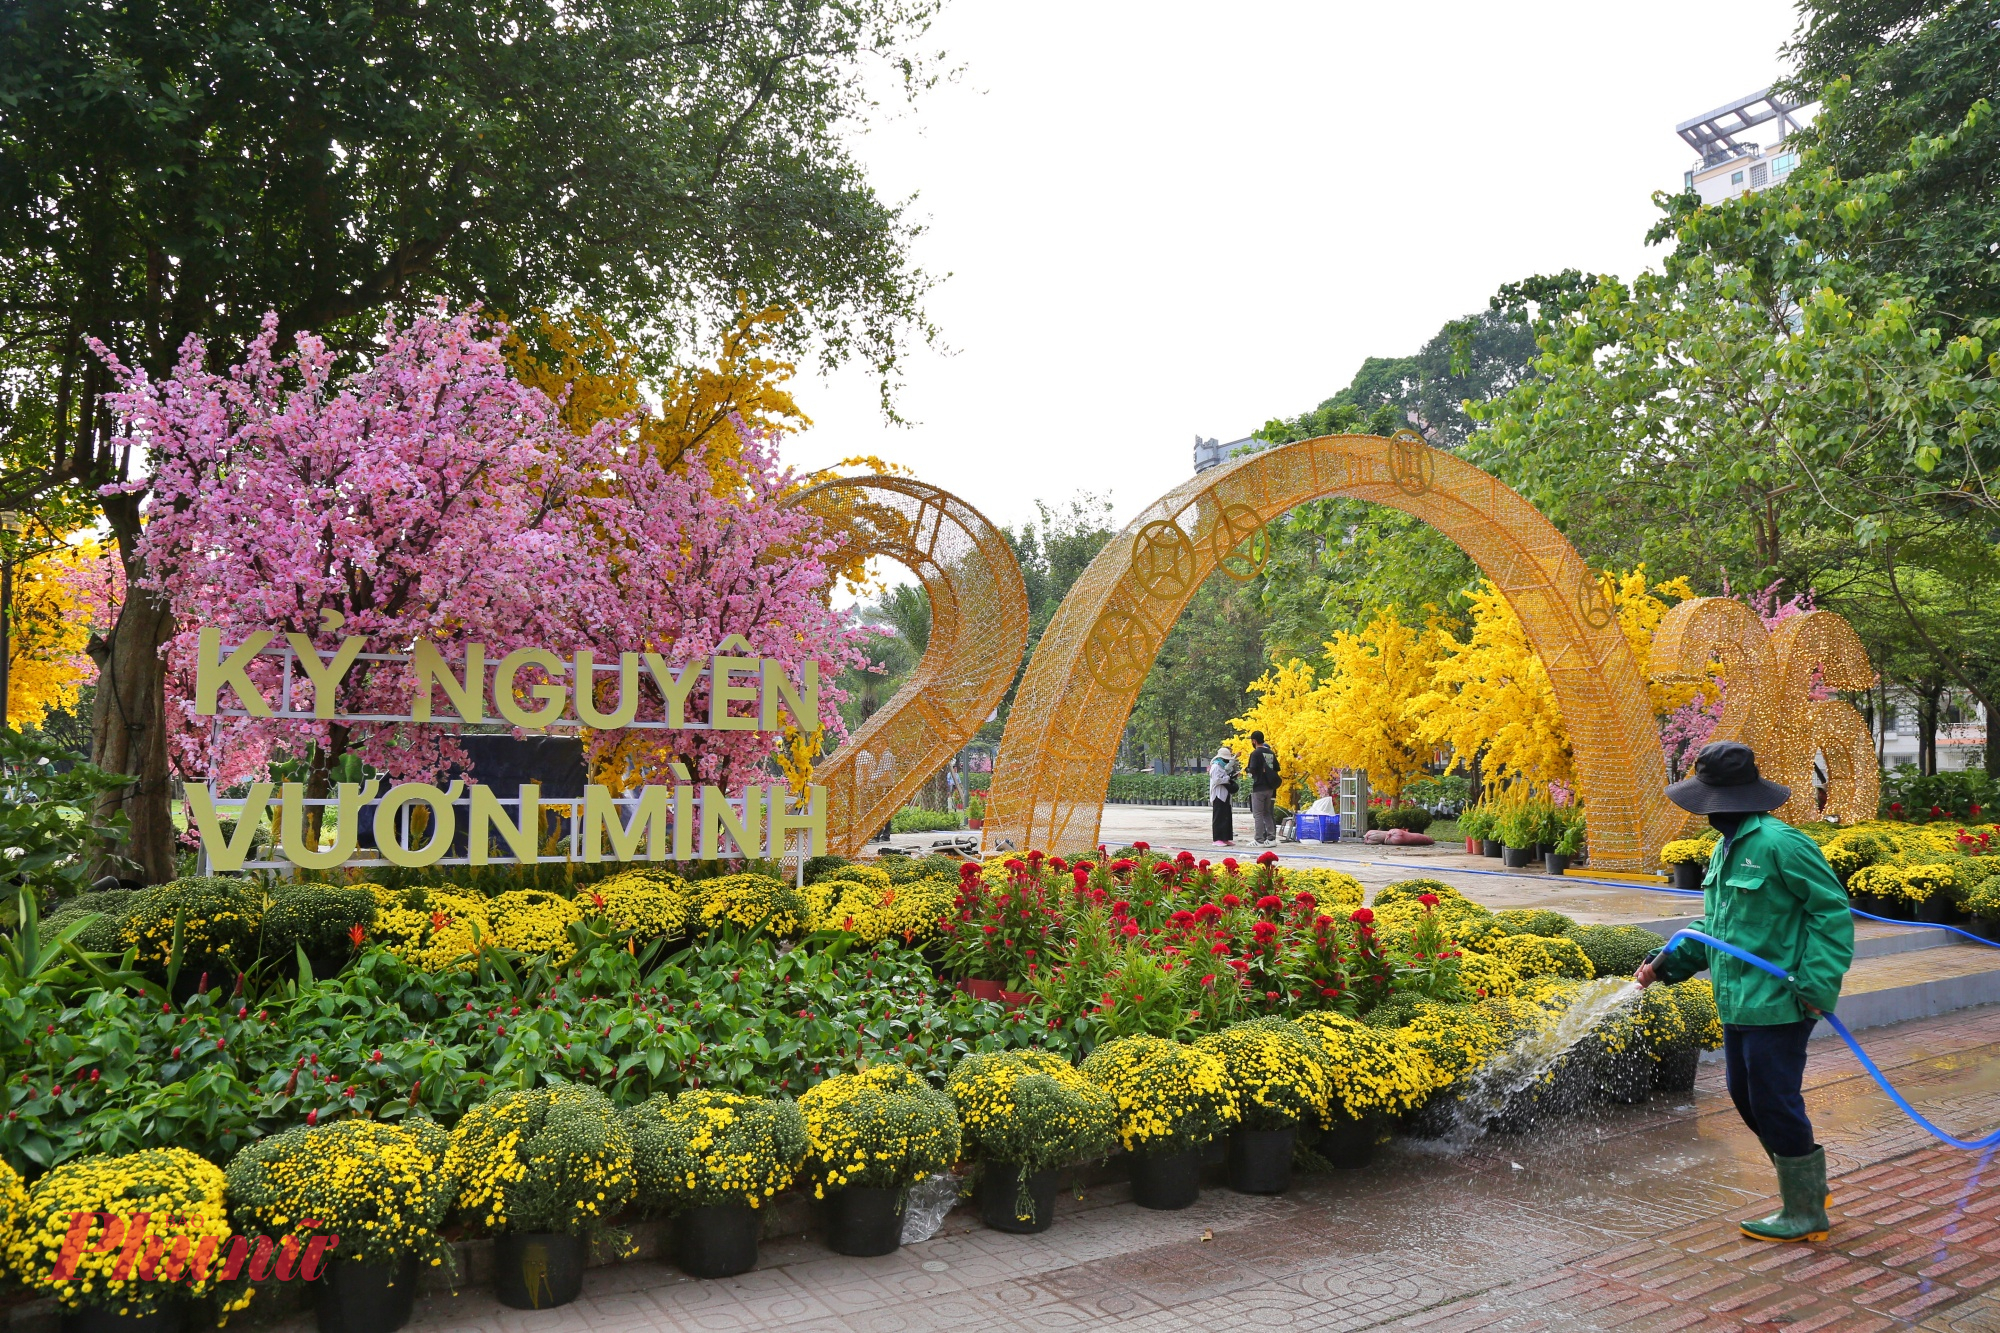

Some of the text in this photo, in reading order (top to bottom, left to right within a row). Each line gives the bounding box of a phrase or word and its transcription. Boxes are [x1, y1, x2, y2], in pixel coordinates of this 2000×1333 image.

[195, 608, 818, 732] KỶ NGUYÊN
[184, 763, 827, 871] VƯƠN MÌNH
